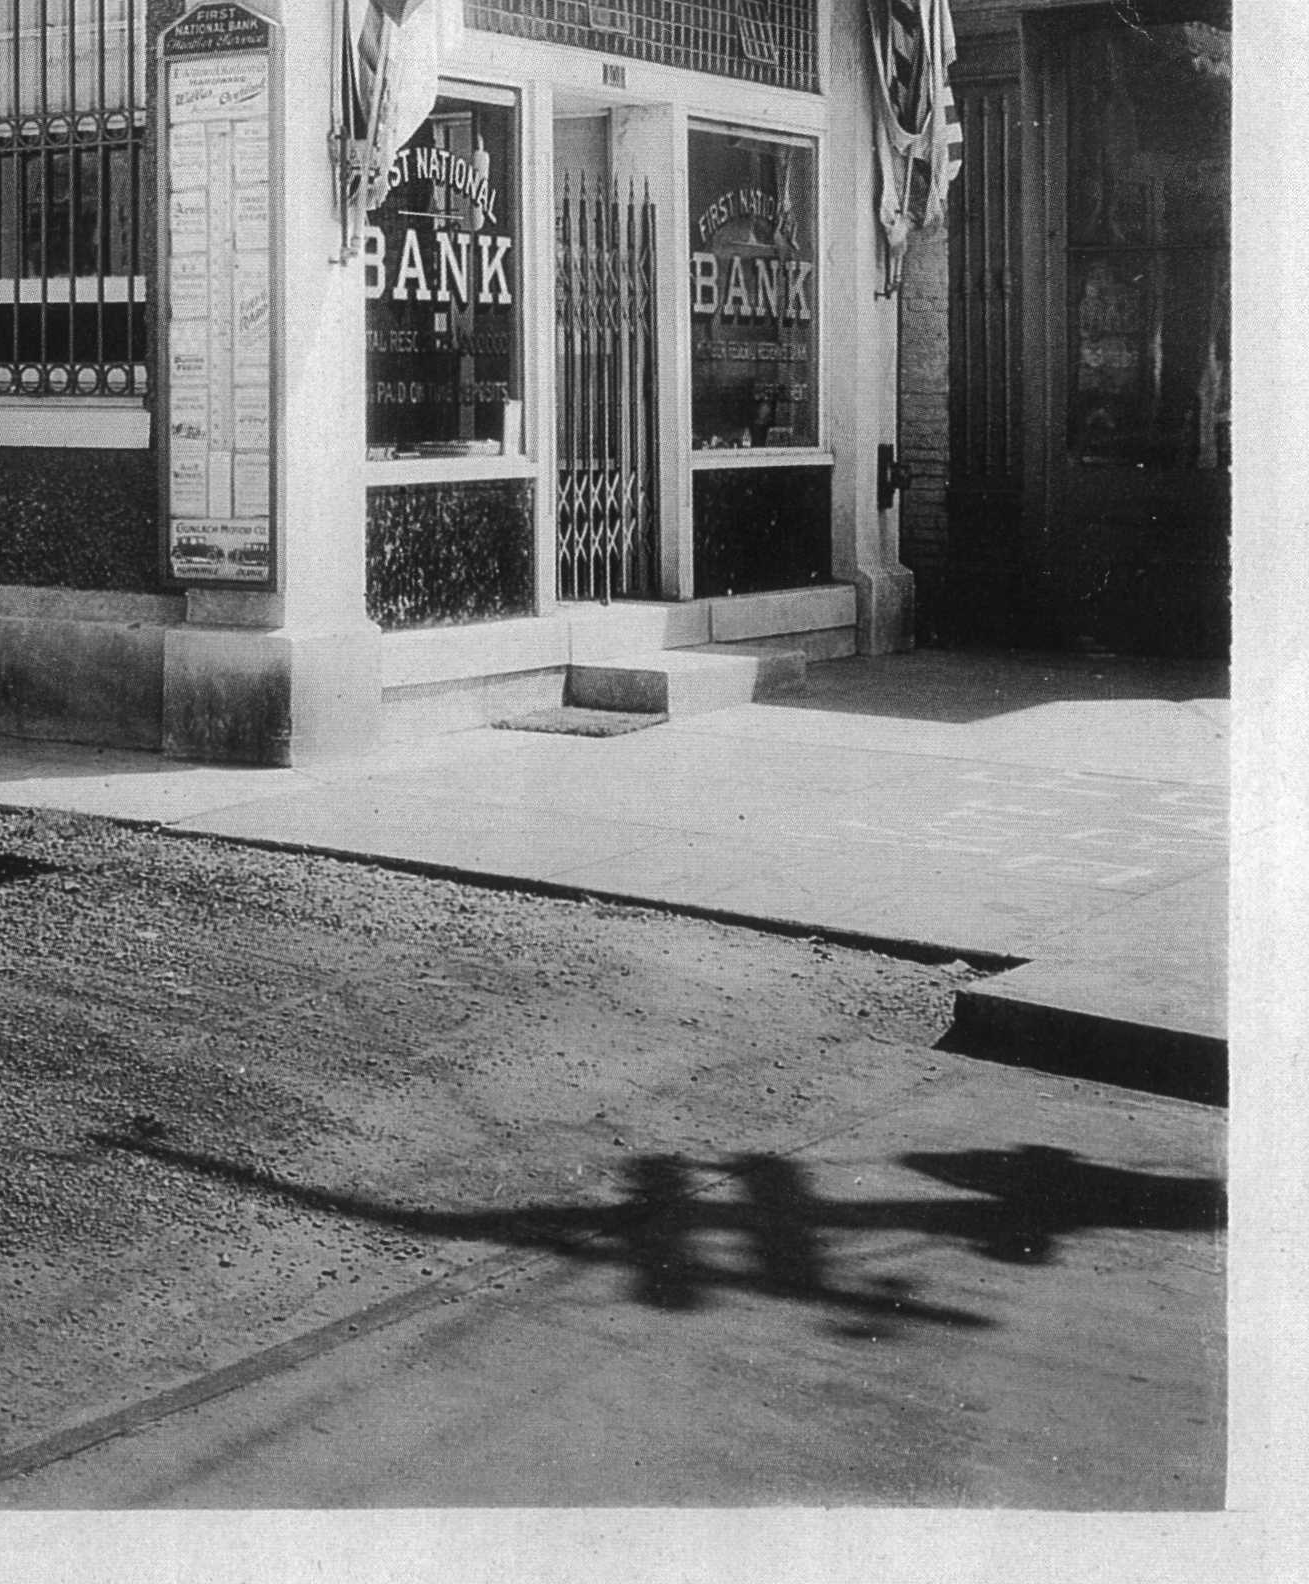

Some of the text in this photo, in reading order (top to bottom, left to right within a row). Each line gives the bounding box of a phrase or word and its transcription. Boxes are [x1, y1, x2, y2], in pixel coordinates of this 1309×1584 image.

[174, 18, 260, 37] NATIONAL BANK
[196, 7, 237, 21] FIRST
[416, 147, 497, 224] NATIONAL
[698, 192, 733, 242] FIRST
[364, 225, 512, 304] BANK
[692, 251, 812, 320] BANK
